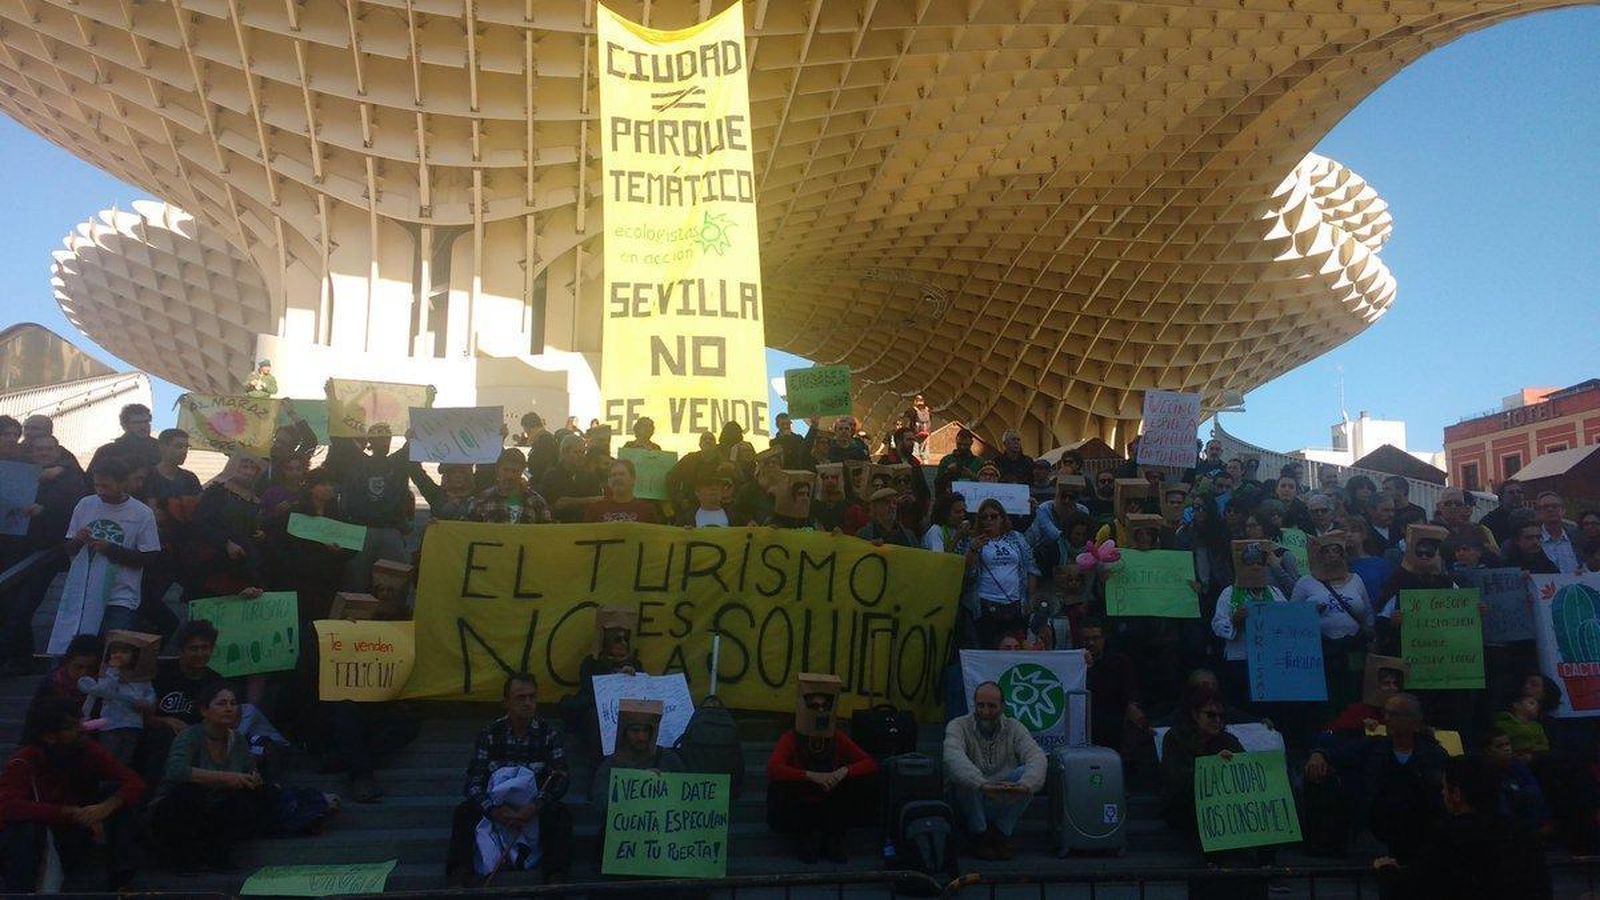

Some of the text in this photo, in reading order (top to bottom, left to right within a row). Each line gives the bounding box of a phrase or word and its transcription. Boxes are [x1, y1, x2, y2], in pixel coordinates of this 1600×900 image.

[607, 40, 742, 83] CIUDAD
[611, 115, 747, 159] PARQUE
[609, 166, 753, 206] TEMÁTICO
[610, 278, 759, 320] SEVILLA
[650, 335, 726, 377] NO
[606, 398, 769, 437] SE VENDE
[1503, 399, 1562, 429] HOTEL
[461, 533, 887, 607] EL TURISMO
[637, 601, 696, 638] ES
[353, 636, 394, 653] venden
[612, 775, 718, 803] ¡VECINA DATE
[1221, 761, 1267, 795] CIUDAD
[665, 809, 727, 833] ESPECULAN
[1202, 797, 1294, 839] NOS CONSUME!
[616, 840, 721, 864] EN TU PUERTA!
